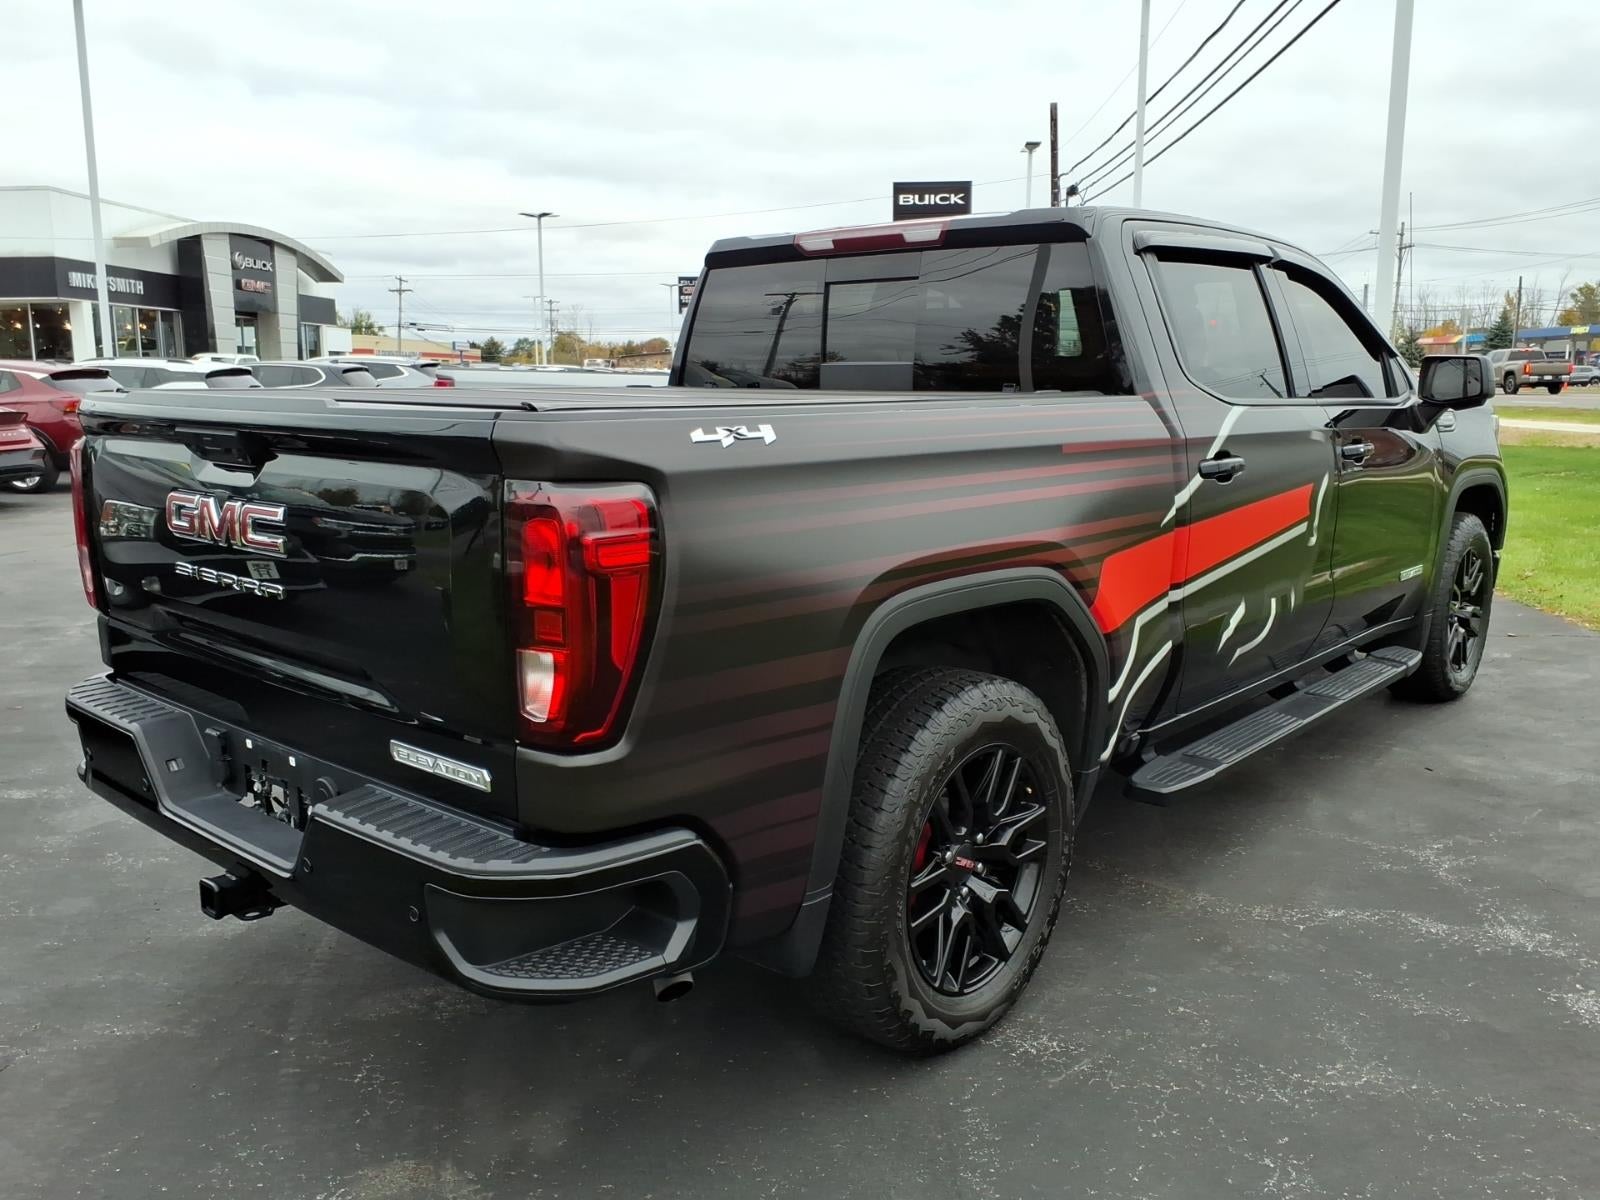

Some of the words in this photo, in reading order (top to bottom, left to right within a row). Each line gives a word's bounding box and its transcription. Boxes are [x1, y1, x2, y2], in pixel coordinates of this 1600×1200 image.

[899, 193, 966, 205] BUICK
[245, 257, 273, 271] BUICK
[68, 271, 98, 290] MIK
[109, 275, 144, 295] SMITH
[165, 489, 288, 558] GMC
[175, 561, 286, 600] SIERRA
[394, 747, 484, 786] ELEVATION
